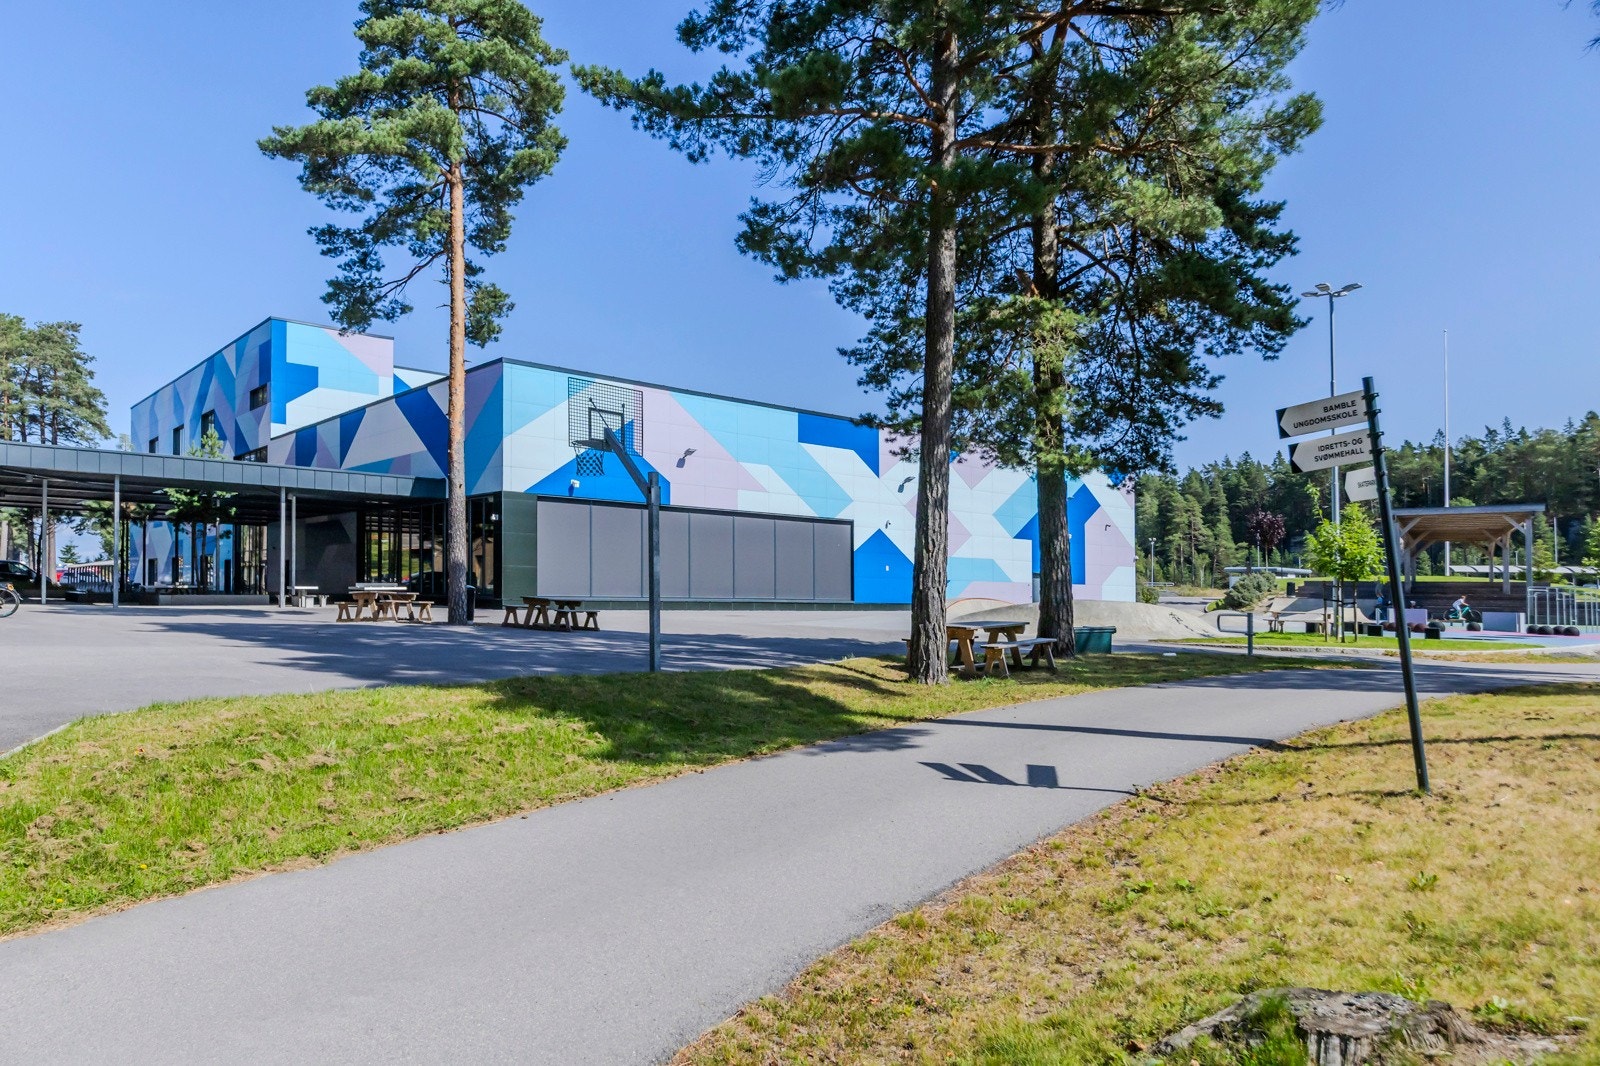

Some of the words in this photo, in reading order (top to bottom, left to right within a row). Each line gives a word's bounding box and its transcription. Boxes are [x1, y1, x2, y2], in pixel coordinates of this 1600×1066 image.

[1323, 400, 1357, 413] BAMBLE
[1293, 409, 1358, 428] UNGDOMSSKOLE
[1318, 441, 1351, 452] IDRETTS-
[1352, 438, 1363, 446] OG
[1314, 447, 1364, 462] SVØMMEHALL
